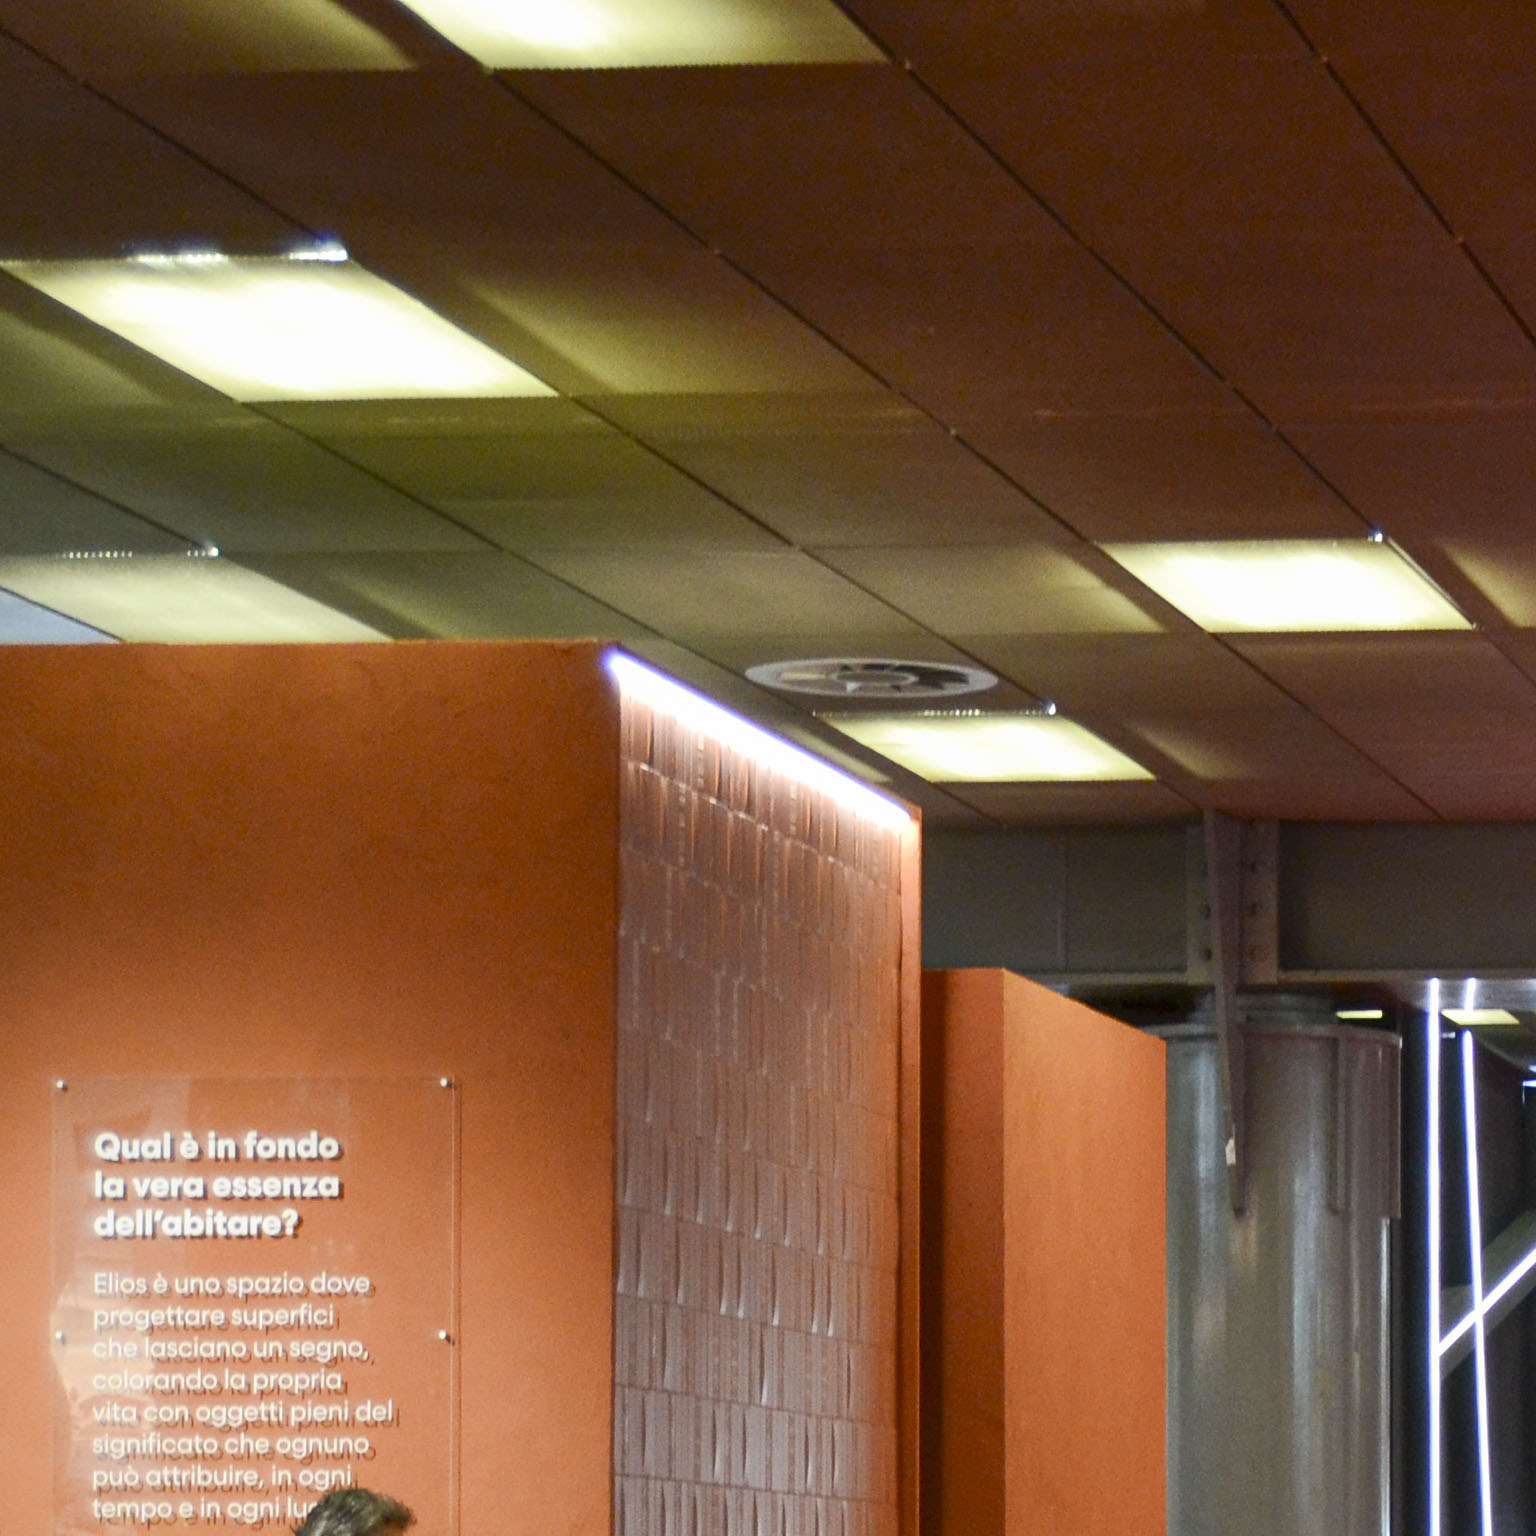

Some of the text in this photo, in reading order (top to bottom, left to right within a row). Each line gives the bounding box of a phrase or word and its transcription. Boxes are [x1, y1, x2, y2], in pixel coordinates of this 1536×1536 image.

[95, 1131, 340, 1161] Qual è in fondo
[95, 1170, 340, 1198] la vera essenza
[94, 1208, 299, 1237] dell'abitare?
[94, 1271, 370, 1299] Elios è uno spazio dove
[94, 1303, 334, 1331] progettare superfici
[93, 1336, 369, 1363] che lasciano un segno,
[93, 1368, 342, 1394] colorando la propria
[93, 1399, 393, 1427] vita con oggetti pieni del
[93, 1432, 370, 1459] significato che ognuno
[93, 1465, 352, 1491] può attribuire, in ogni
[92, 1496, 318, 1523] tempo e in ogni lu
